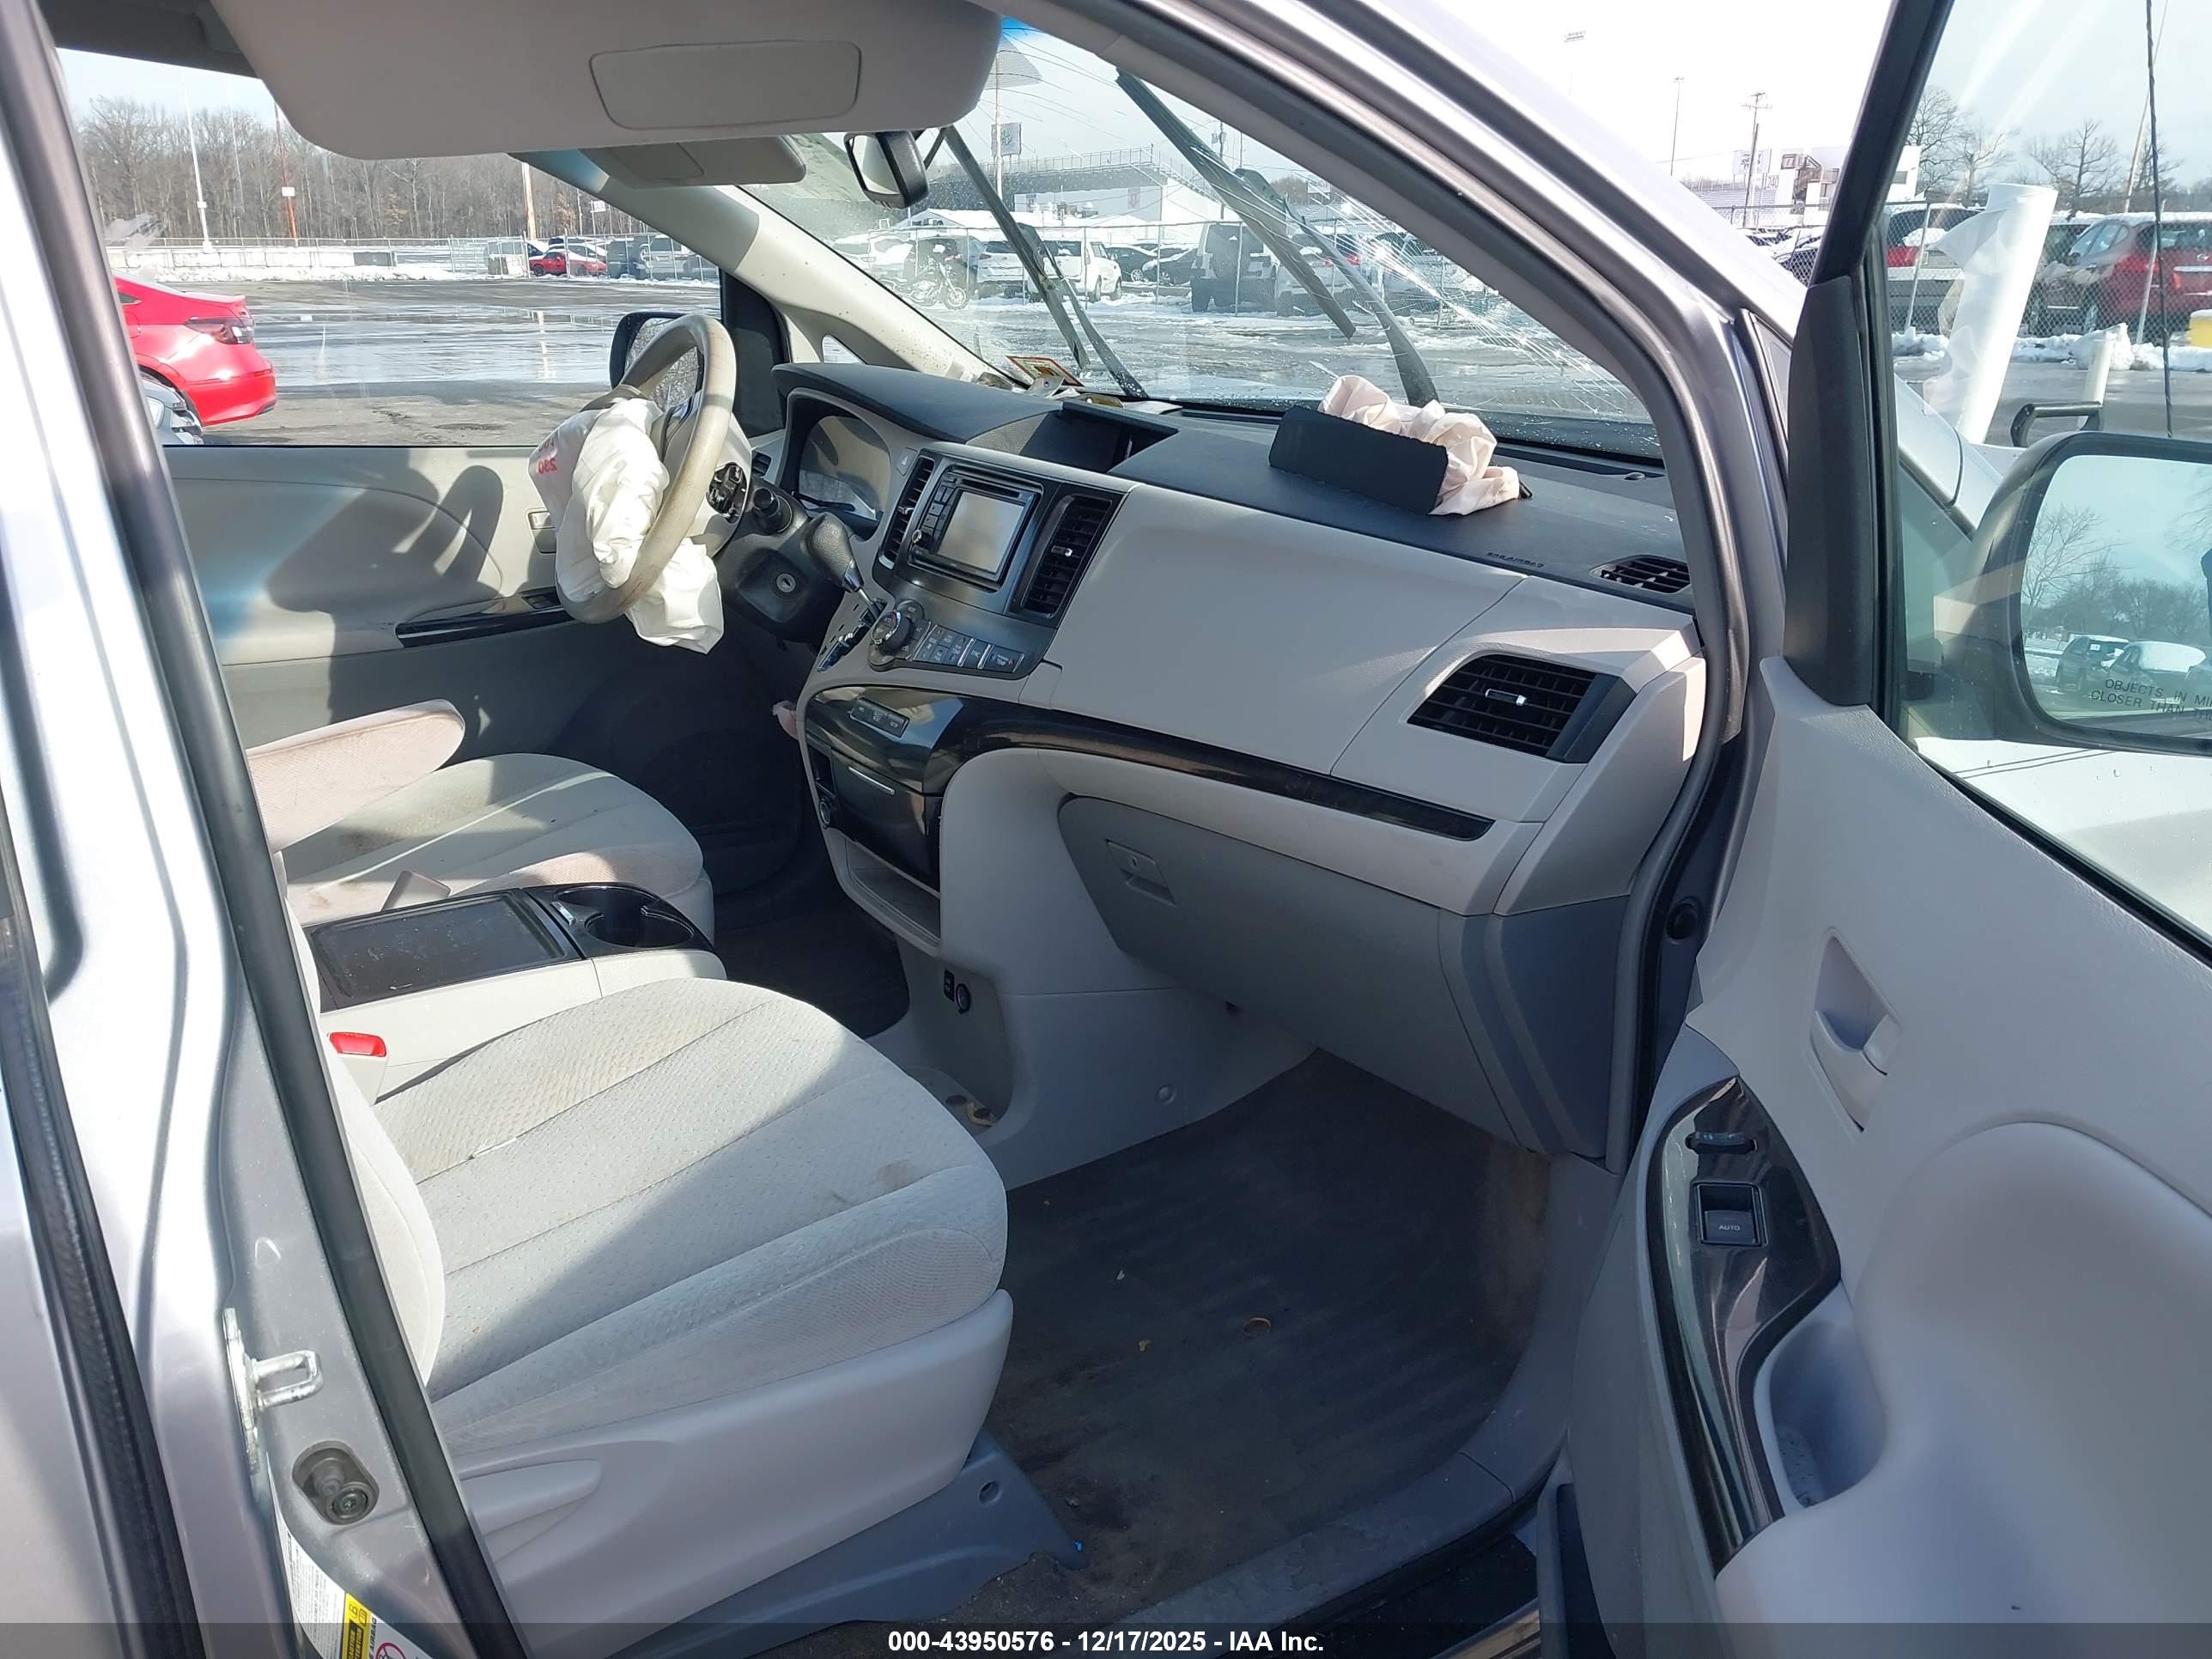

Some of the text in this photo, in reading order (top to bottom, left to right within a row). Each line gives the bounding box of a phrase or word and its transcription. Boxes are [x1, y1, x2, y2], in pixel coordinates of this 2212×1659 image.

[2091, 690, 2142, 708] CLOSER
[2150, 700, 2185, 714] THAN
[2105, 678, 2164, 697] OBJECTS
[2174, 690, 2187, 702] IN
